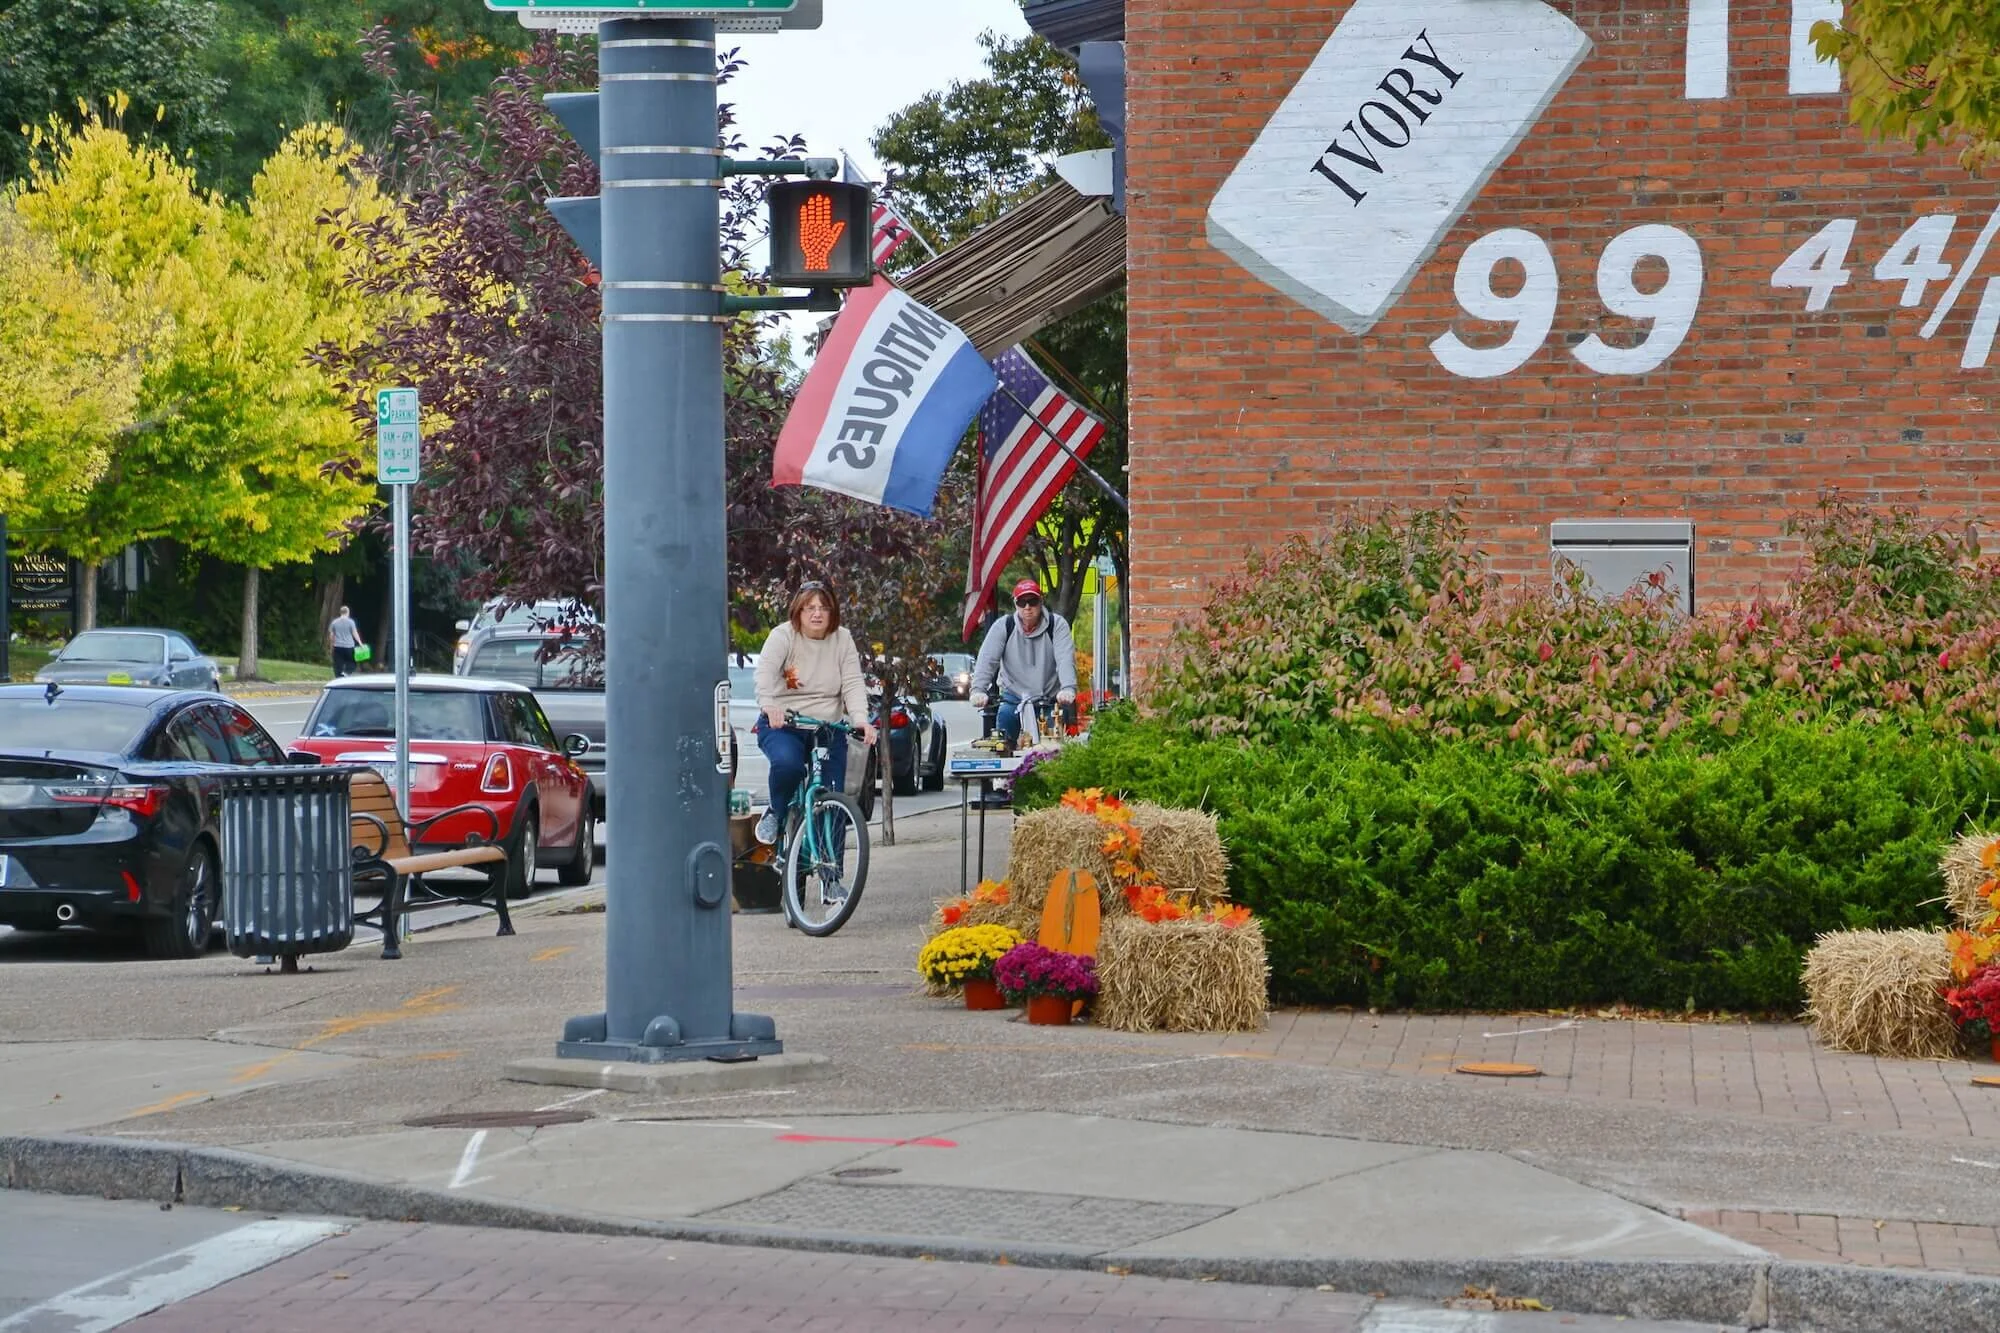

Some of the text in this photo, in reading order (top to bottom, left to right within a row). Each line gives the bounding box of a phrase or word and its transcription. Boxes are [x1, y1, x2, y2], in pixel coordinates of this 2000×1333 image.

[1310, 28, 1464, 208] IVORY
[1429, 224, 1703, 378] 99
[380, 397, 390, 419] 3
[383, 431, 395, 442] 9AM
[402, 448, 413, 460] SAT
[13, 563, 66, 572] MANSION
